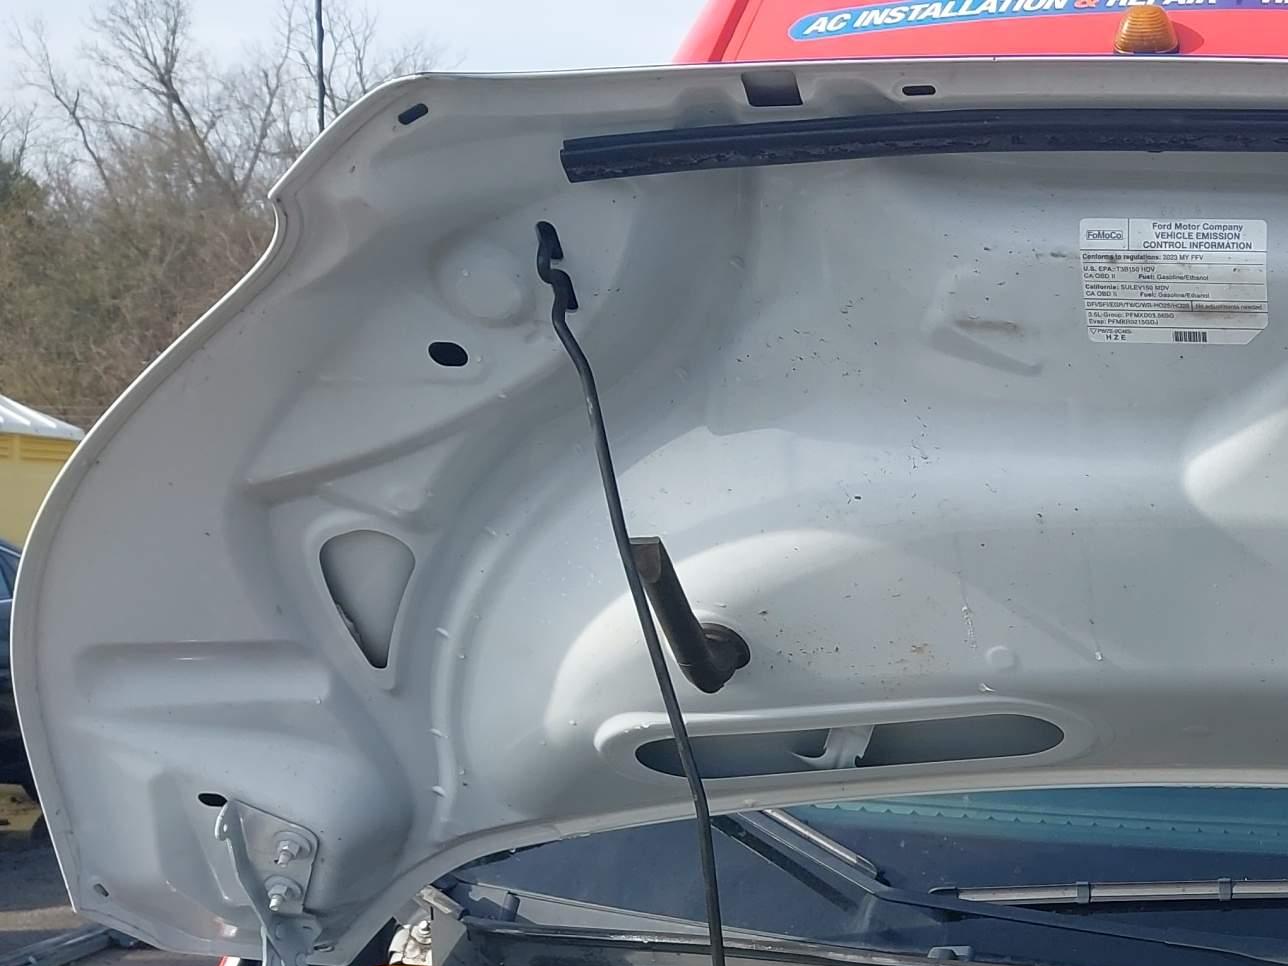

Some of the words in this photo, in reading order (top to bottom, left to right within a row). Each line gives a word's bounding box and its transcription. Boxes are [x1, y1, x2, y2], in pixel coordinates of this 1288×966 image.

[804, 14, 846, 35] AC
[853, 0, 1068, 29] INSTALLATION
[1152, 223, 1172, 231] Ford
[1175, 223, 1200, 231] Motor
[1202, 223, 1244, 233] Company
[1087, 231, 1122, 240] FoMoCo
[1155, 232, 1194, 240] VEHICLE
[1196, 232, 1241, 240] EMISSION
[1143, 241, 1188, 249] CONTROL
[1189, 241, 1252, 250] INFORMATION
